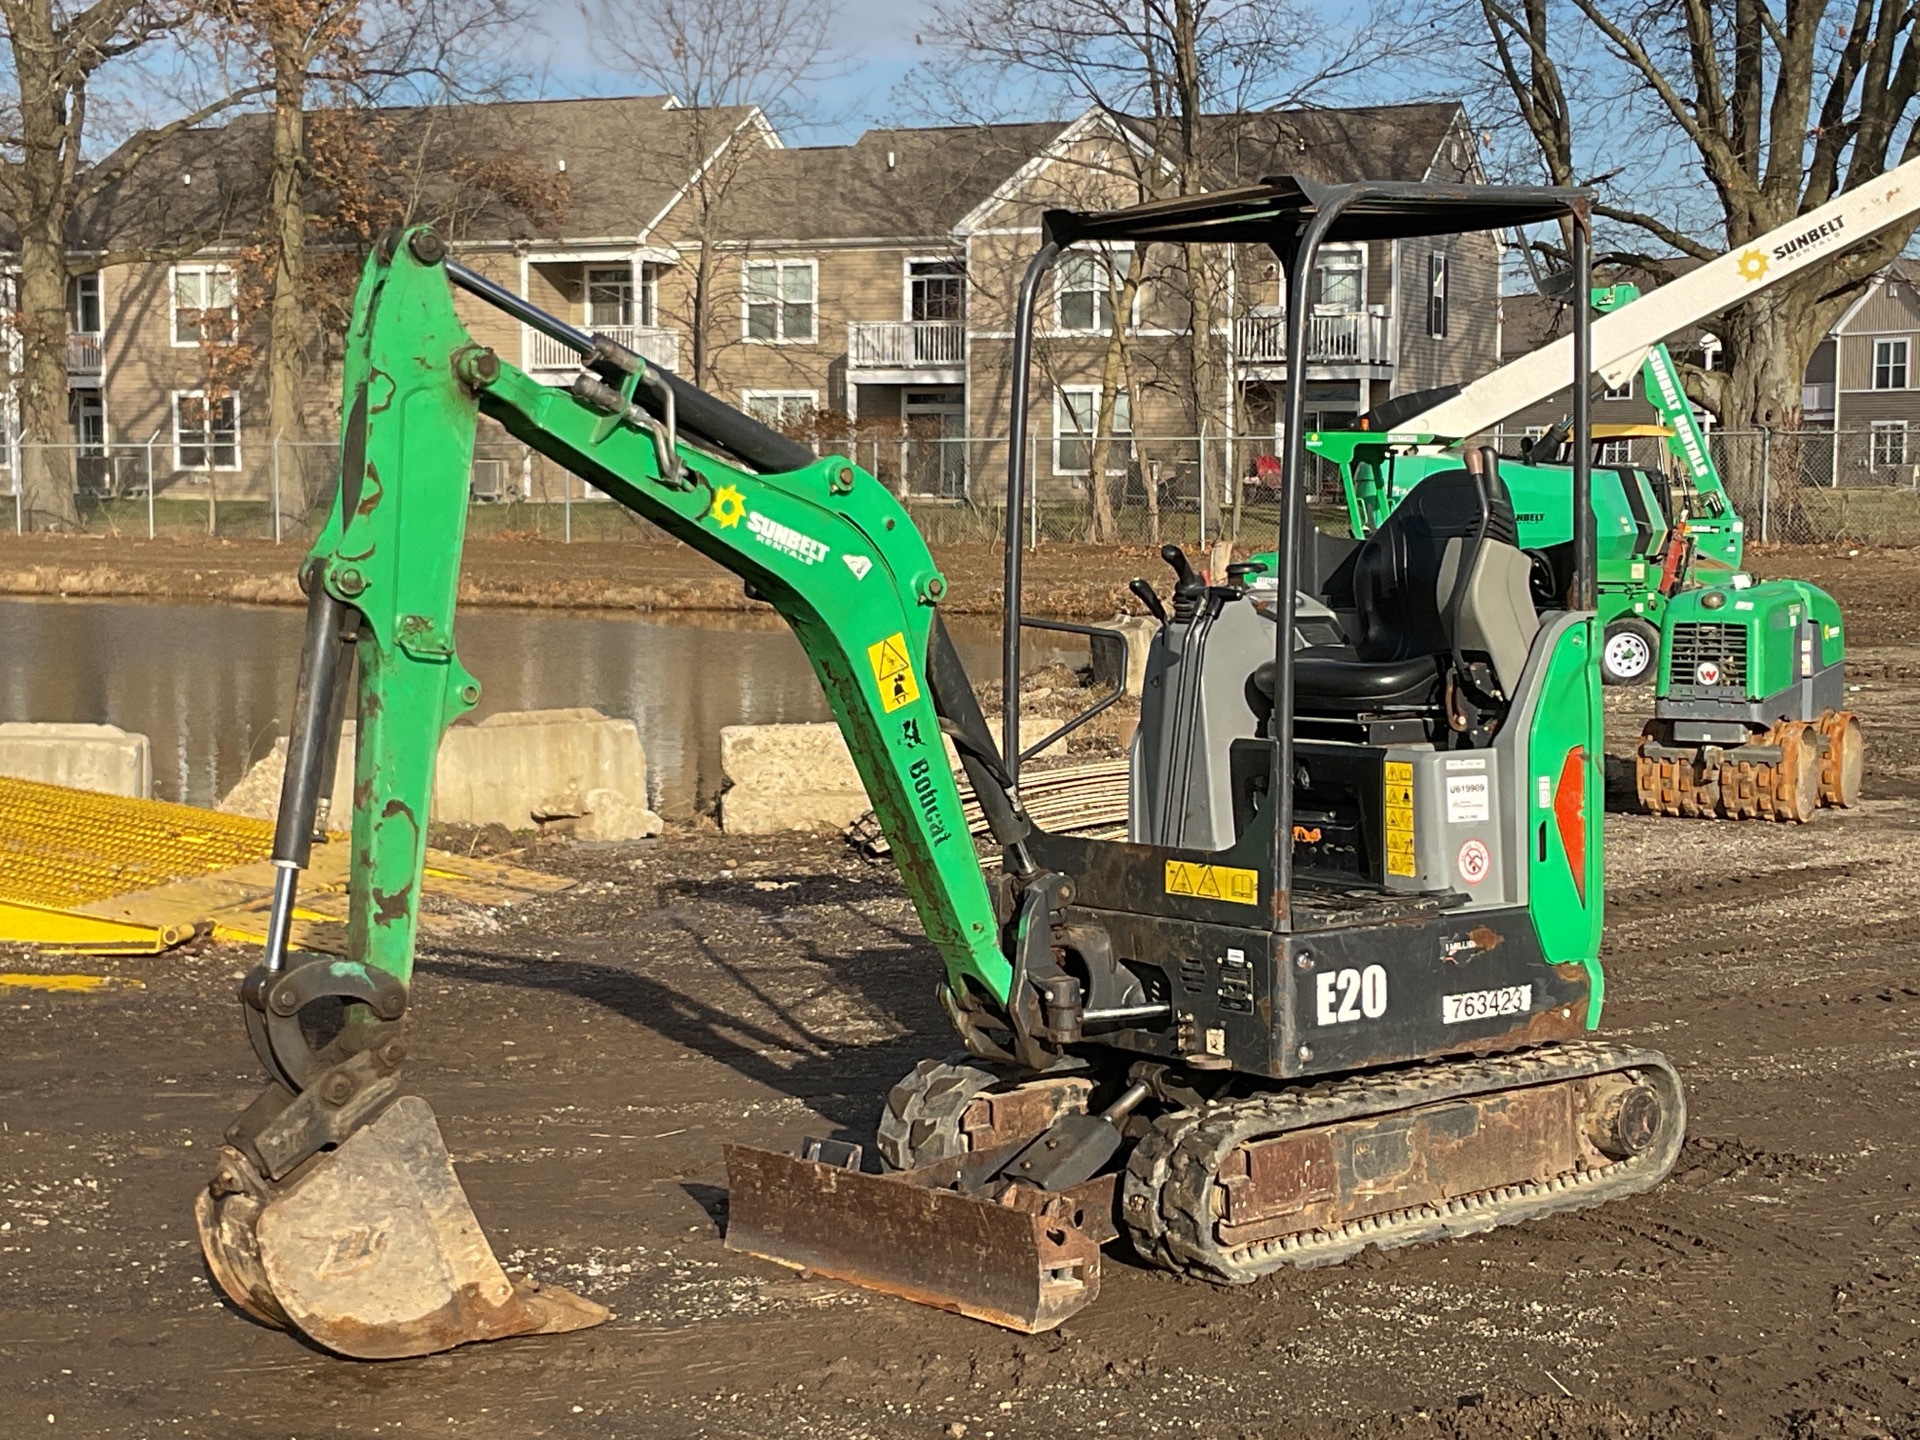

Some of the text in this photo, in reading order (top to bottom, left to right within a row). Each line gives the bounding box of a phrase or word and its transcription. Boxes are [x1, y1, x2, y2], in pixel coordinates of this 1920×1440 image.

[1773, 214, 1845, 261] SUNBELT
[1788, 231, 1841, 262] RENTALS
[1648, 349, 1709, 478] SUNBELT RENTALS
[747, 511, 830, 562] SUNBELT
[1516, 513, 1545, 522] NBELT
[756, 534, 814, 566] RENTALS
[909, 757, 952, 848] Bobcat
[1316, 964, 1387, 1026] E20
[1452, 989, 1523, 1018] 763423
